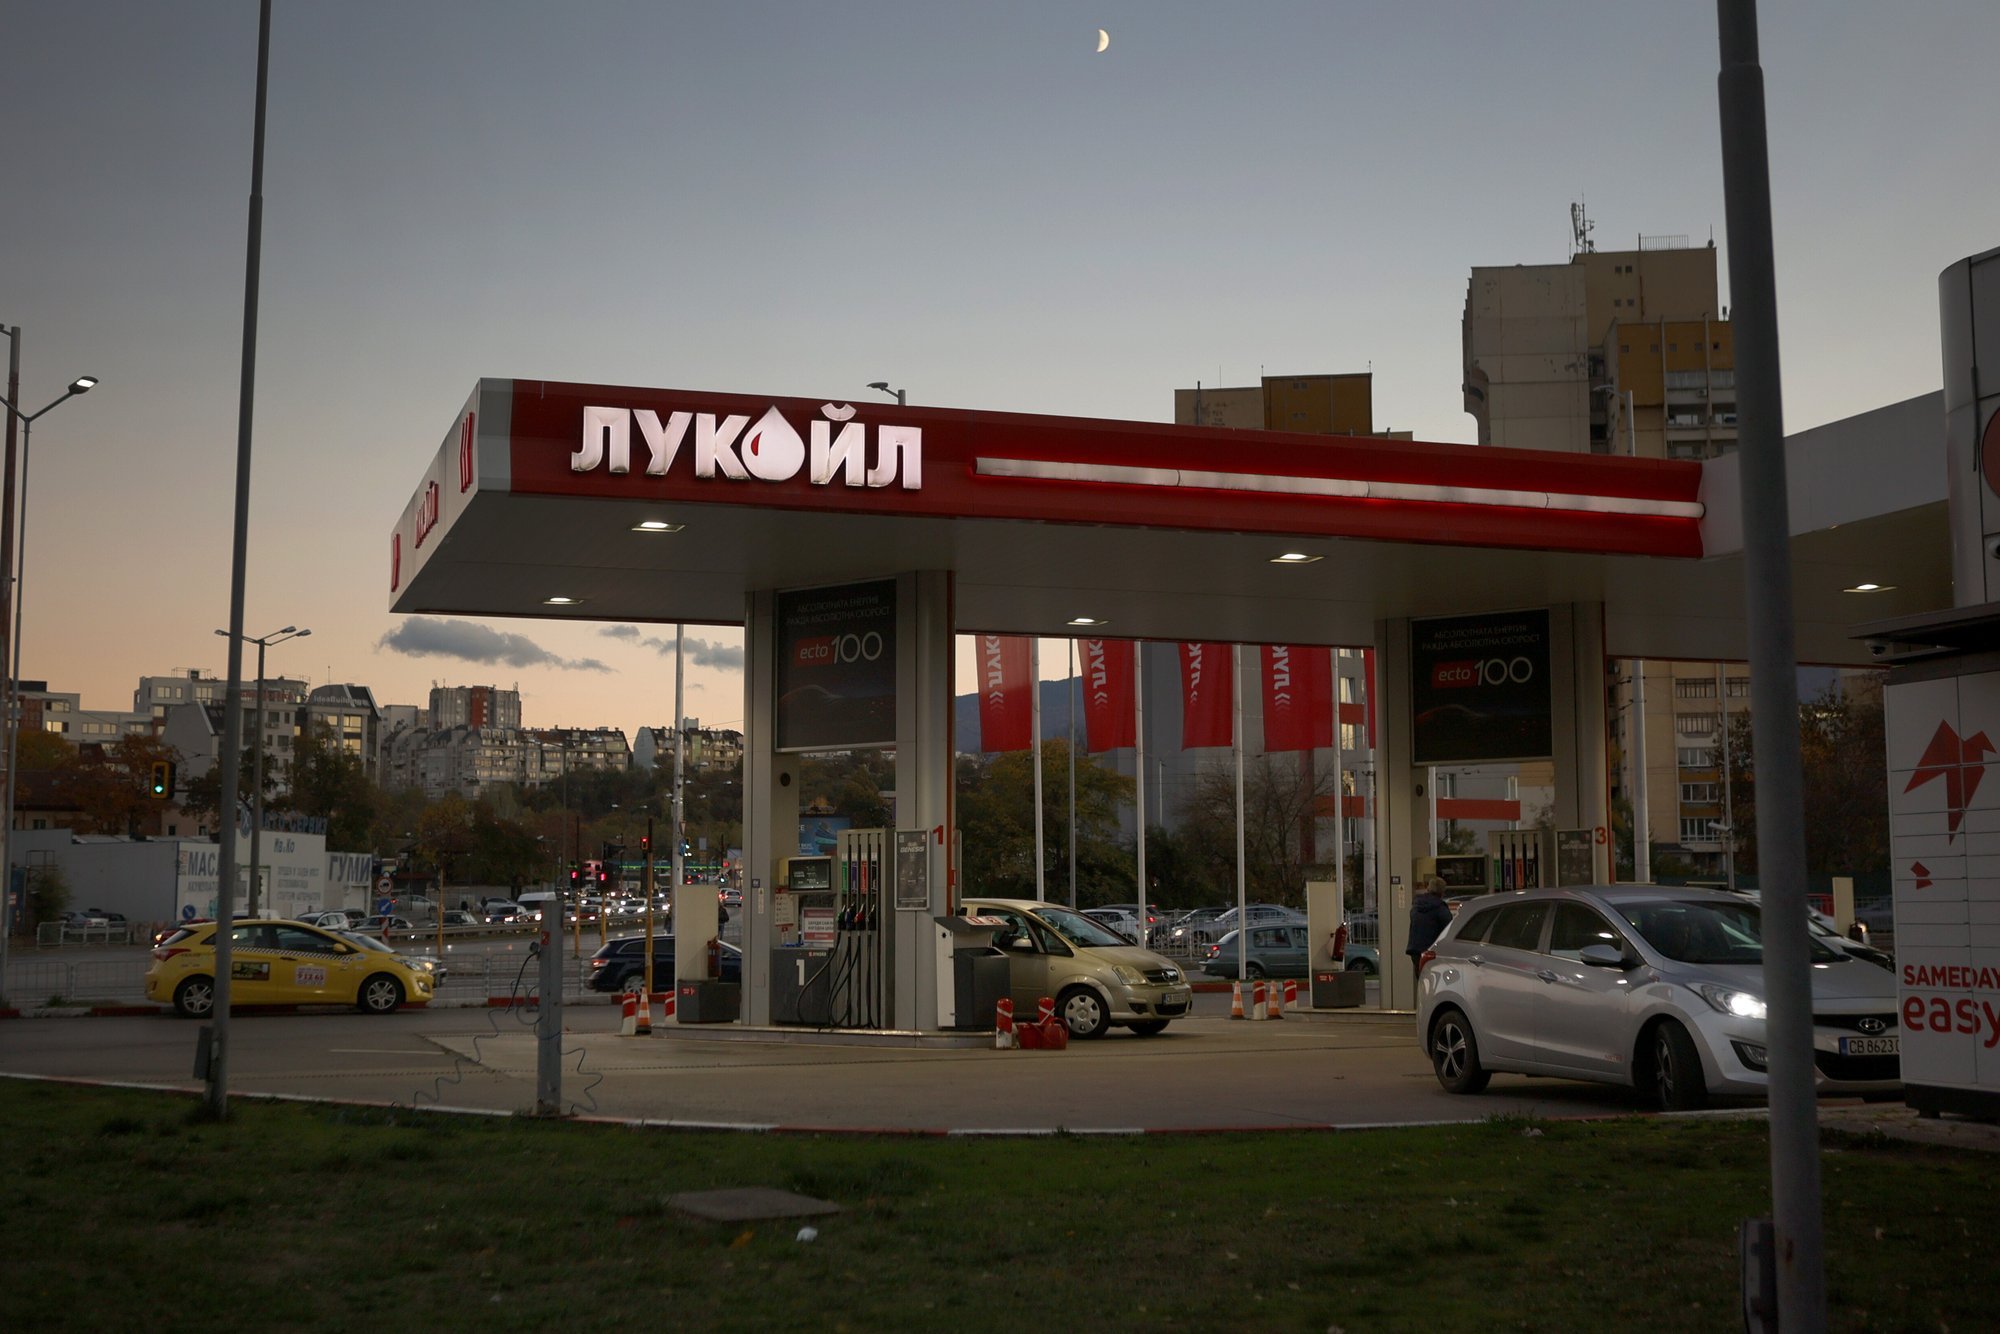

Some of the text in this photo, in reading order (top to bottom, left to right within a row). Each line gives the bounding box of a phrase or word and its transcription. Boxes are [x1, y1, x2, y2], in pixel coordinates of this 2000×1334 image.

[571, 402, 922, 489] ЛУКОЙЛ
[932, 825, 944, 845] 1
[1595, 826, 1607, 845] 3
[187, 851, 221, 877] МАС
[328, 854, 371, 883] ГУМИ
[795, 959, 805, 986] 1
[1903, 965, 2000, 989] SAMEDAY
[1903, 996, 2000, 1049] easy
[1867, 1039, 1894, 1053] 8623
